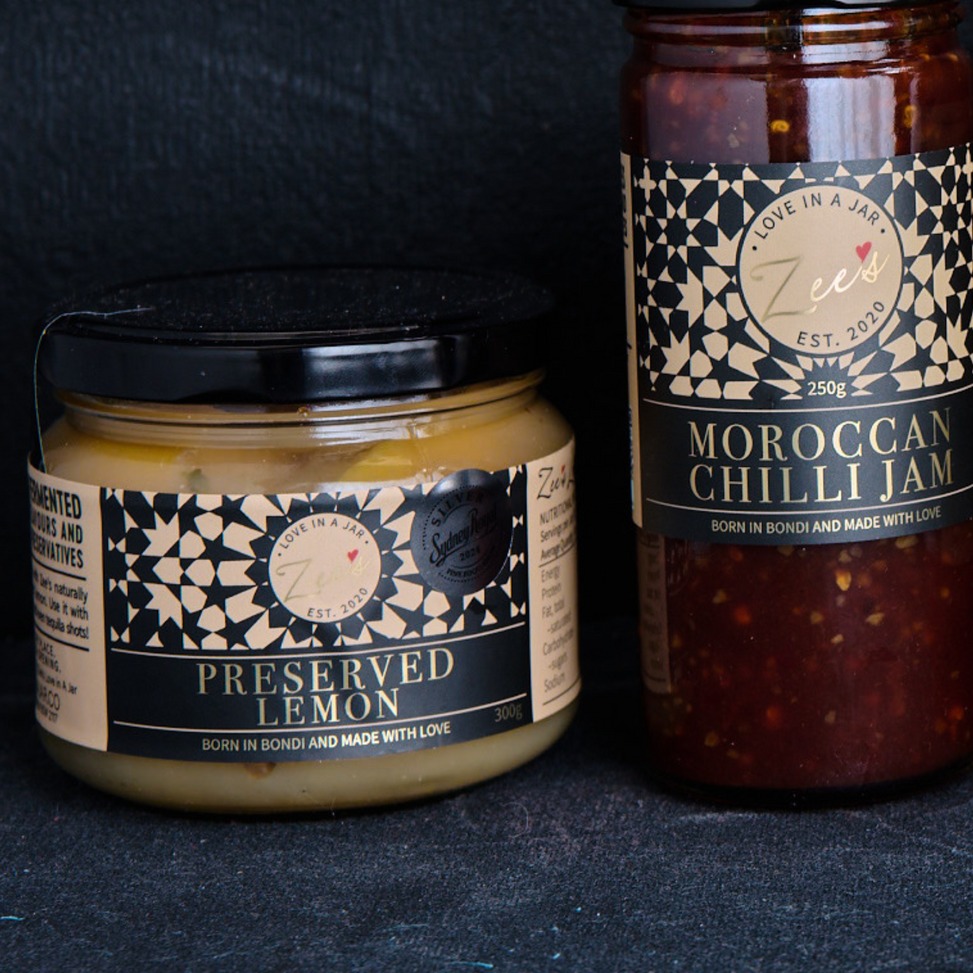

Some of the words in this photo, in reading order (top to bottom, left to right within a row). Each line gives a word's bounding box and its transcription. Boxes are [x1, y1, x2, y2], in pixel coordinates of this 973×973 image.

[754, 200, 796, 239] LOVE
[802, 192, 822, 208] IN
[830, 193, 841, 207] A
[848, 199, 880, 226] JAR
[797, 331, 840, 348] EST.
[847, 301, 885, 341] 2020
[807, 380, 847, 399] 250g
[687, 406, 951, 461] MOROCCAN
[690, 462, 862, 504] CHILLI
[880, 449, 954, 503] JAM
[61, 520, 84, 544] AND
[280, 523, 308, 549] LOVE
[312, 517, 325, 528] IN
[330, 518, 338, 527] A
[342, 522, 365, 539] JAR
[711, 520, 746, 533] BORN
[749, 521, 762, 534] IN
[766, 521, 810, 534] BONDI
[813, 520, 841, 533] AND
[844, 516, 881, 531] MADE
[882, 512, 913, 527] WITH
[916, 505, 942, 522] LOVE
[429, 531, 470, 567] Sydney
[54, 582, 88, 605] naturally
[307, 607, 336, 618] EST.
[341, 587, 368, 613] 2020
[70, 605, 89, 621] with
[196, 647, 454, 695] PRESERVED
[256, 688, 399, 726] LEMON
[494, 702, 523, 723] 300g
[202, 737, 240, 751] BORN
[243, 737, 256, 751] IN
[261, 736, 305, 750] BONDI
[309, 734, 338, 749] AND
[341, 730, 380, 747] MADE
[382, 725, 416, 743] WITH
[419, 721, 451, 738] LOVE
